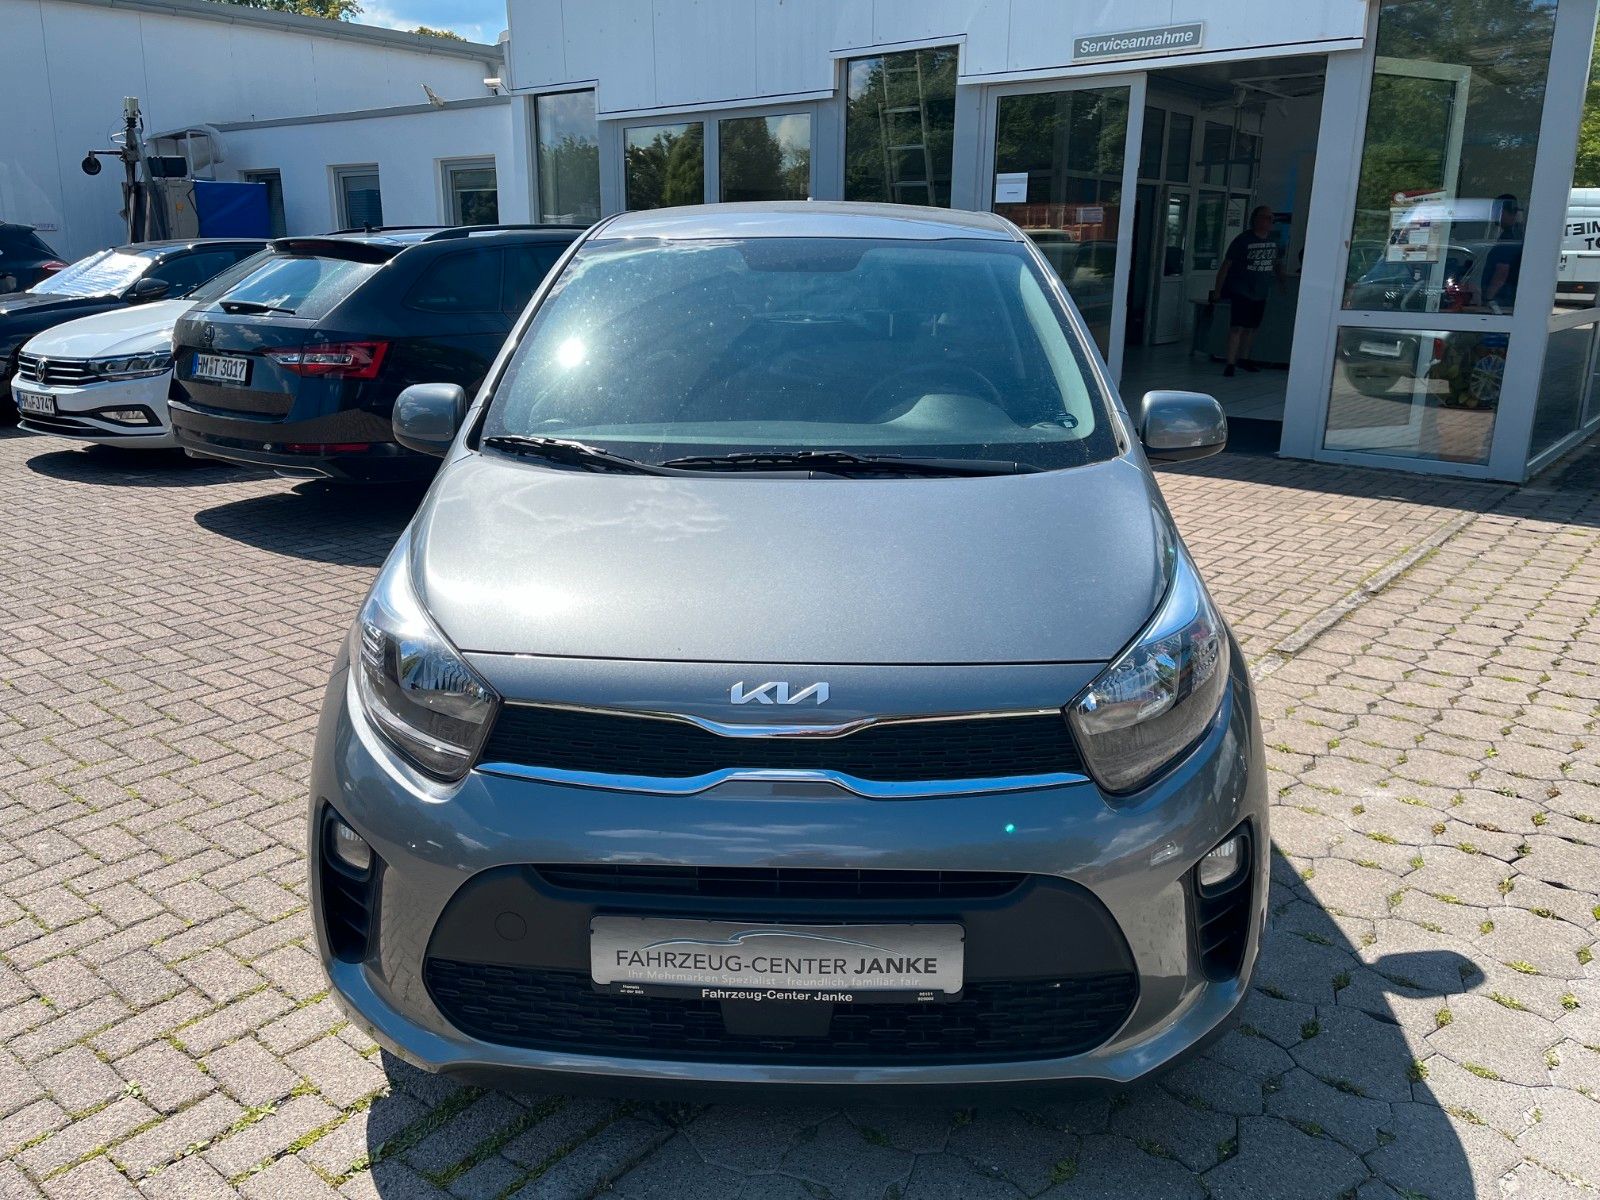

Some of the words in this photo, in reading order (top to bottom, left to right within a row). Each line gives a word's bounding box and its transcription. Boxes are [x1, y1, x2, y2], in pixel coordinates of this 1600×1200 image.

[1079, 31, 1194, 54] Serviceannahme
[731, 681, 829, 705] KIA
[616, 950, 847, 975] FAHRZEUG-CENTER
[854, 957, 937, 975] JANKE
[628, 970, 643, 979] Ihr
[646, 971, 719, 984] Mehrmarken
[722, 974, 776, 987] Spezialist
[702, 988, 811, 1001] Fahrzeug-Center
[813, 991, 853, 1002] Janke
